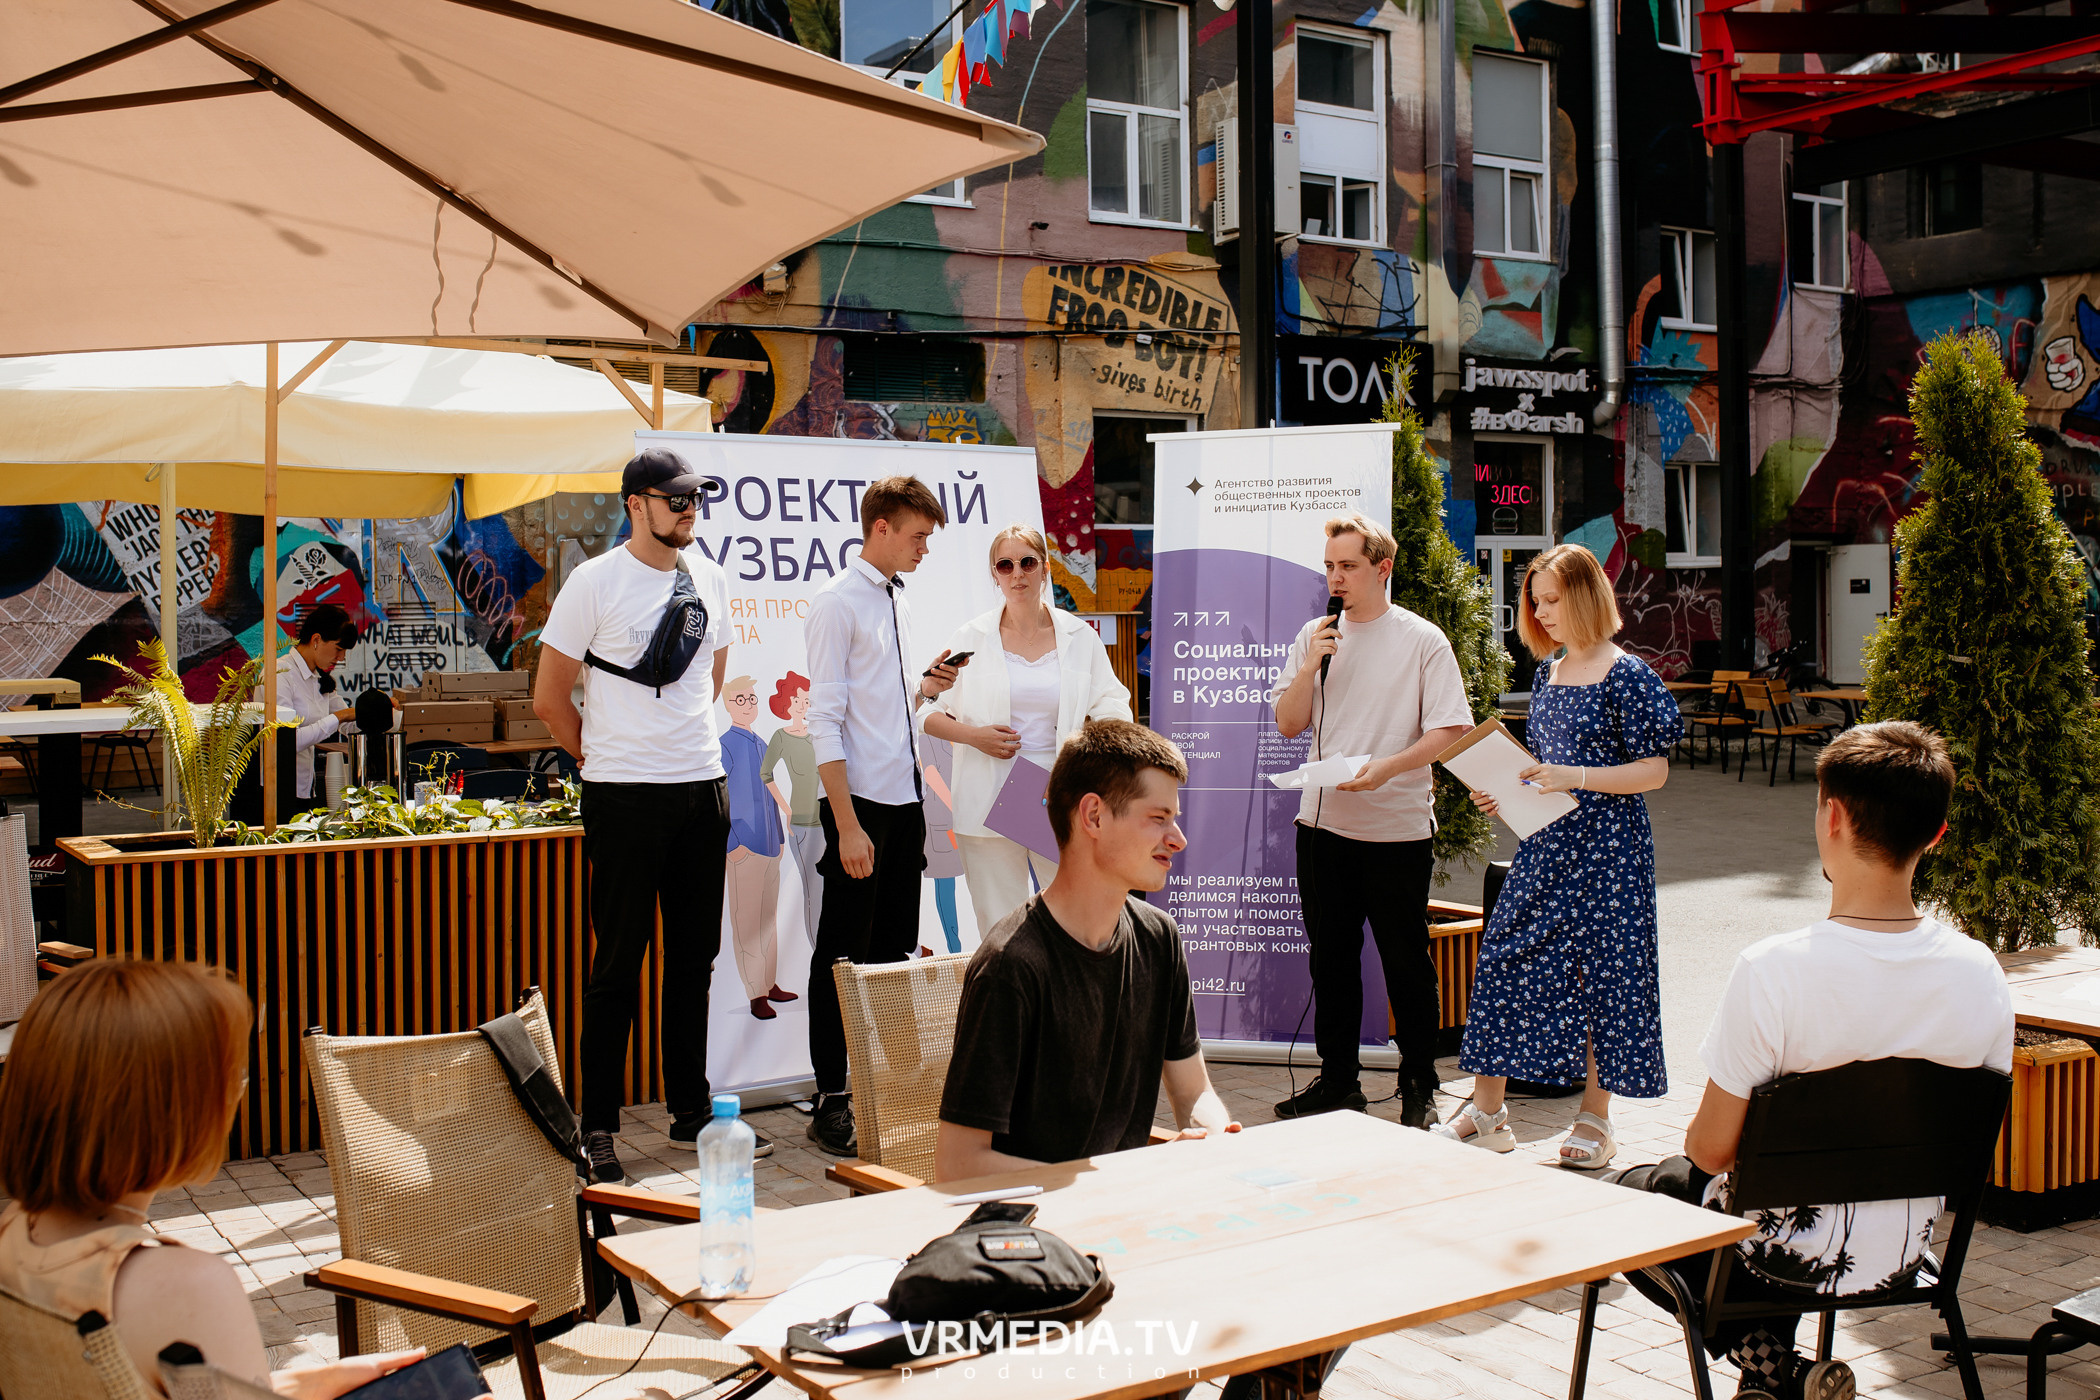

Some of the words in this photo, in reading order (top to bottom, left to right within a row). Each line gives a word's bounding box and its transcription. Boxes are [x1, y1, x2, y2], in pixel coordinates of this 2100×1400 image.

[1048, 265, 1223, 344] INCREDIBLE
[1461, 358, 1590, 397] jawsspot
[1096, 362, 1147, 394] gives
[1154, 376, 1203, 411] birth
[1214, 478, 1273, 489] Агентство
[1278, 477, 1332, 488] развития
[700, 470, 989, 525] РОЕКТЙ
[1214, 490, 1301, 501] общественных
[1305, 488, 1361, 498] проектов
[1225, 503, 1286, 513] инициатив
[1290, 500, 1347, 512] Кузбасса
[106, 503, 161, 542] WHO
[678, 535, 864, 582] УЗБАС
[730, 598, 758, 618] ЯЯ
[765, 599, 809, 618] ПРО
[1173, 665, 1281, 685] проектир
[339, 673, 402, 692] WHEN
[1173, 690, 1185, 703] в
[1194, 684, 1272, 708] Кузбас
[1171, 731, 1210, 740] РАСКРОЙ
[1174, 741, 1195, 749] ВОЙ
[1183, 752, 1221, 760] ТЕНЦИАЛ
[1169, 876, 1192, 886] мы
[1197, 875, 1283, 889] реализуем
[1168, 891, 1236, 904] делимся
[1168, 907, 1228, 919] опытом
[1234, 909, 1243, 919] и
[1249, 909, 1304, 920] помога
[1178, 923, 1197, 934] ам
[1203, 924, 1303, 937] участвовать
[1182, 940, 1266, 953] грантовых
[1272, 942, 1312, 953] конк
[1192, 978, 1246, 992] pi42.ru
